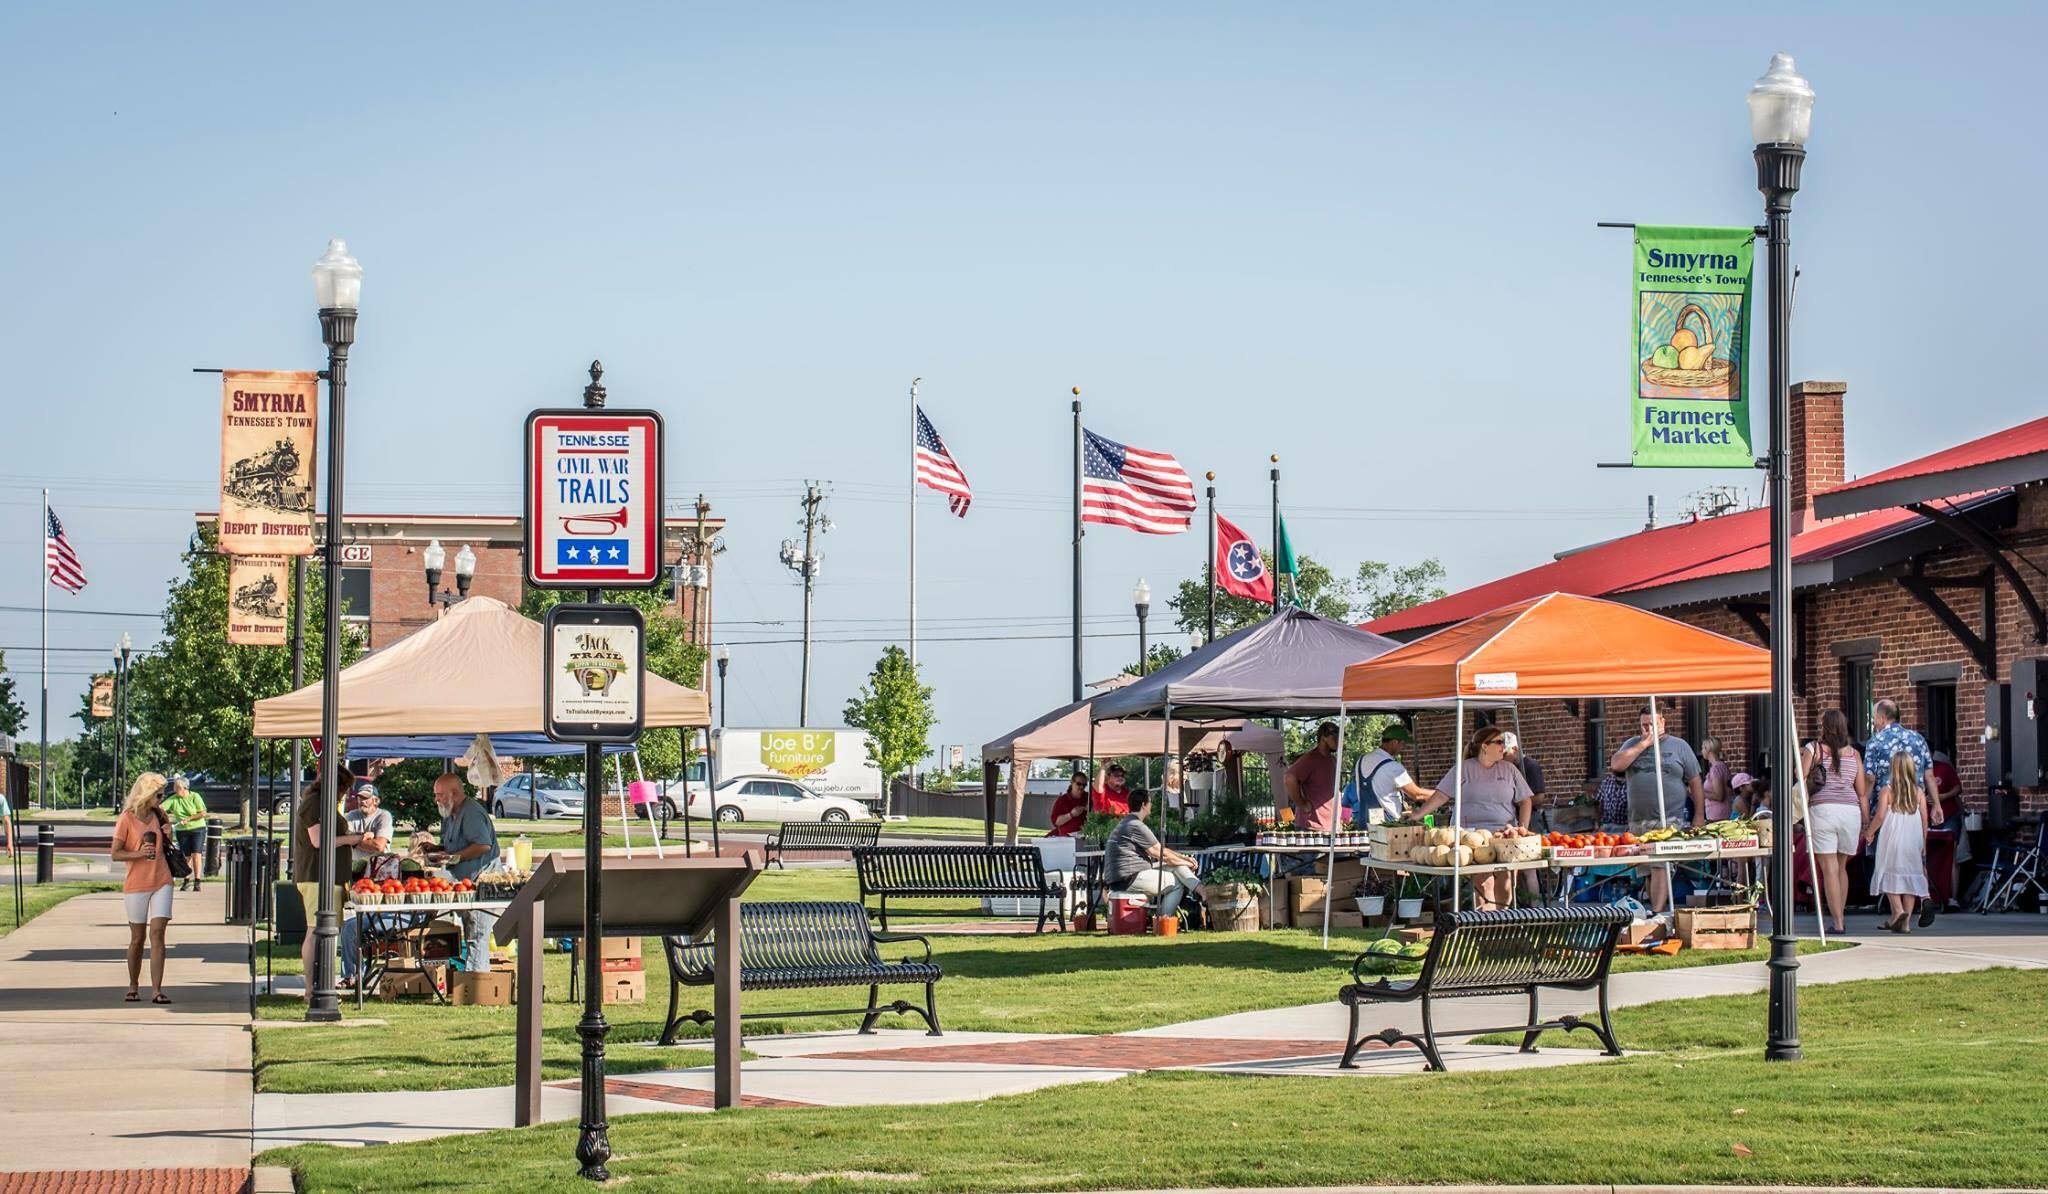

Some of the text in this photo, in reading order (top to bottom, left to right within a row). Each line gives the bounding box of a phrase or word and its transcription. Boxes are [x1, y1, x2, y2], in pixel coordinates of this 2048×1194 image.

[1647, 248, 1738, 272] Smyrna
[1639, 272, 1747, 285] Tennessee's Town
[233, 390, 306, 413] SMYRNA
[1645, 407, 1736, 426] Farmers
[558, 435, 630, 447] TENNESSEE
[1651, 427, 1732, 445] Market
[557, 458, 630, 475] CIVIL WAR
[557, 479, 630, 504] TRAILS
[224, 522, 312, 536] DEPOT DISTRICT
[570, 652, 623, 660] TRAIL
[762, 733, 832, 751] Joe B's
[777, 763, 828, 775] mattress
